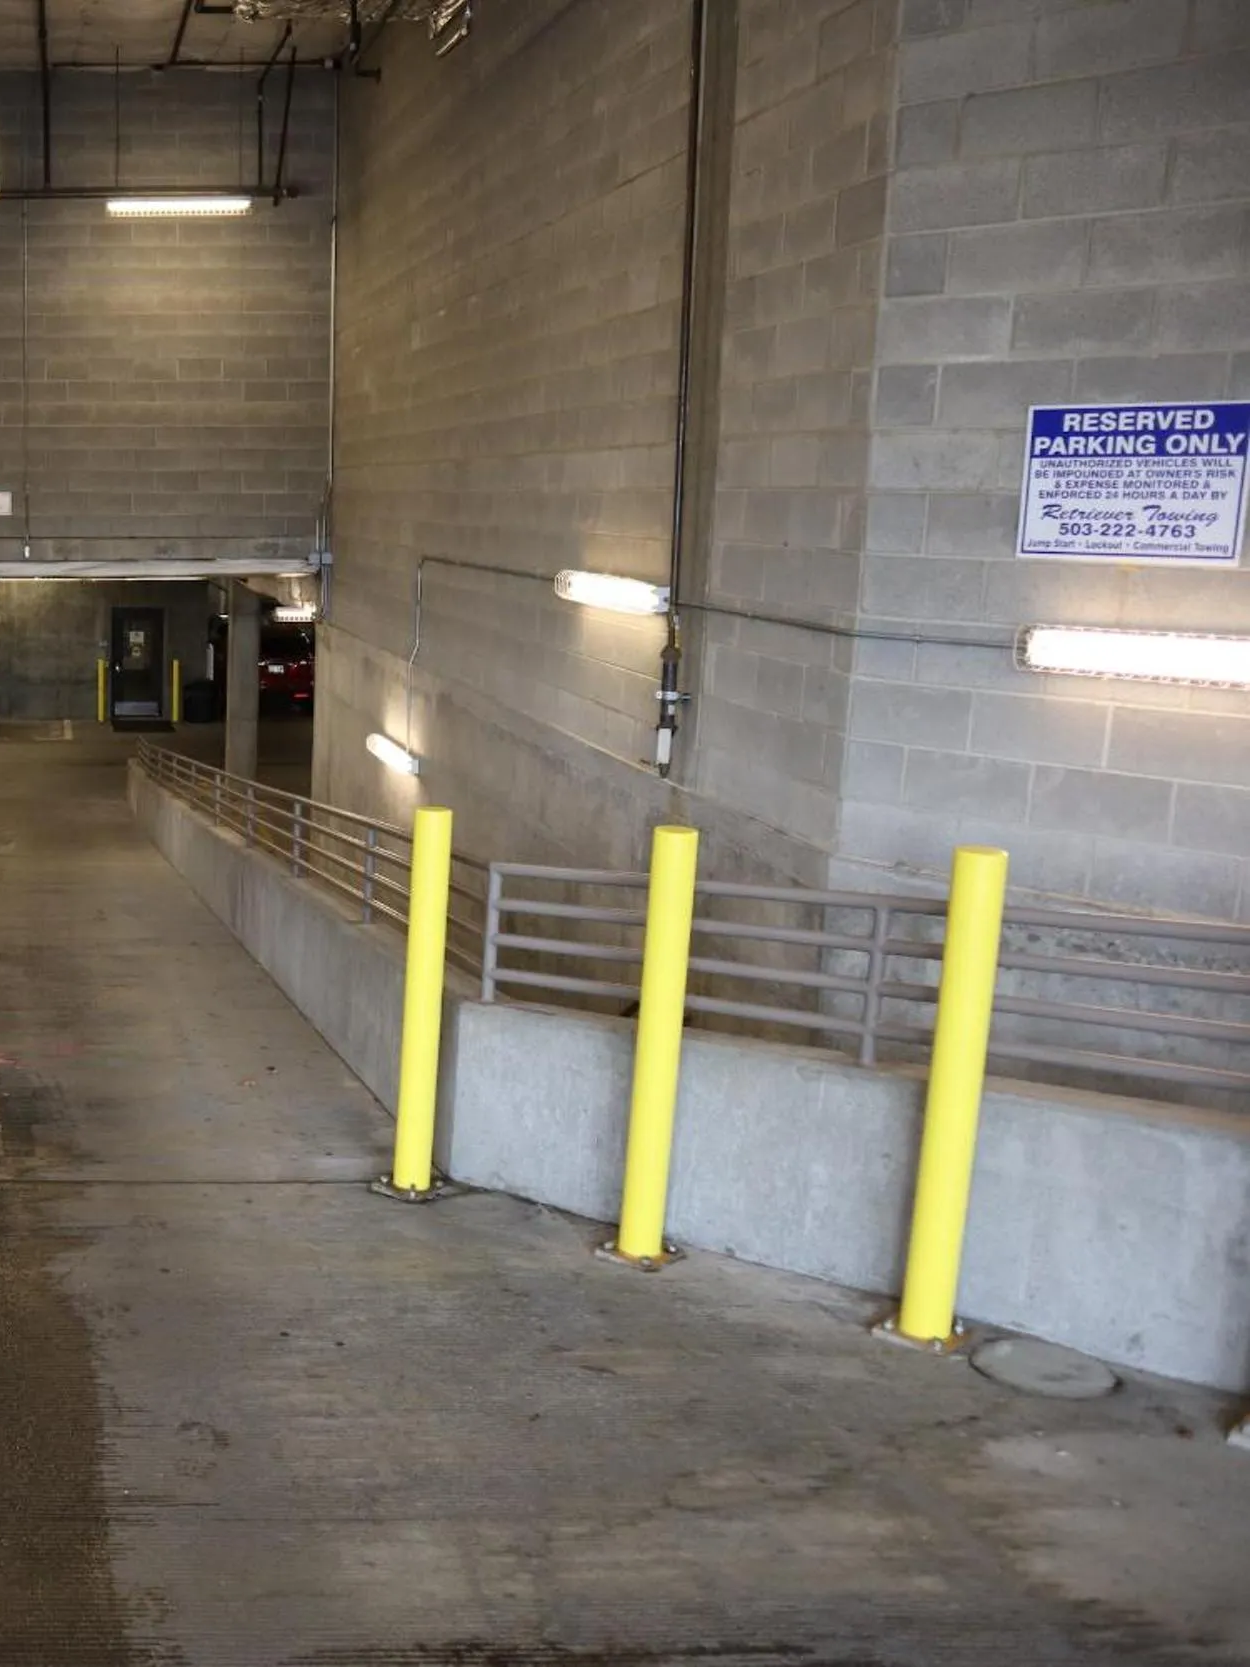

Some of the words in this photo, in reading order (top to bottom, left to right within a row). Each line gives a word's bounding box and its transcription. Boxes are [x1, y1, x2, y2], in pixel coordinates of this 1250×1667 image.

[1063, 409, 1215, 432] RESERVED
[1033, 435, 1156, 455] PARKING
[1165, 432, 1246, 455] ONLY
[1040, 459, 1133, 468] UNAUTHORIZED
[1136, 458, 1197, 468] VEHICLES
[1201, 458, 1233, 468] WILL
[1034, 469, 1050, 479] BE
[1053, 469, 1124, 479] IMPOUNDED
[1127, 469, 1142, 478] AT
[1206, 469, 1236, 478] RISK
[1065, 480, 1119, 489] EXPENSE
[1123, 480, 1199, 489] MONITORED
[1038, 490, 1103, 499] ENFORCED
[1105, 490, 1119, 499] 24
[1123, 490, 1165, 499] HOURS
[1170, 491, 1177, 499] A
[1182, 491, 1207, 500] DAY
[1211, 491, 1228, 500] BY
[1041, 504, 1133, 521] Retriever
[1142, 505, 1219, 527] Towing
[1059, 523, 1196, 538] 503-222-4763
[1028, 539, 1051, 548] Jump
[1054, 539, 1075, 547] Start
[1086, 540, 1122, 549] Lockout
[1133, 541, 1191, 551] Commercial
[1194, 542, 1230, 553] Towing
